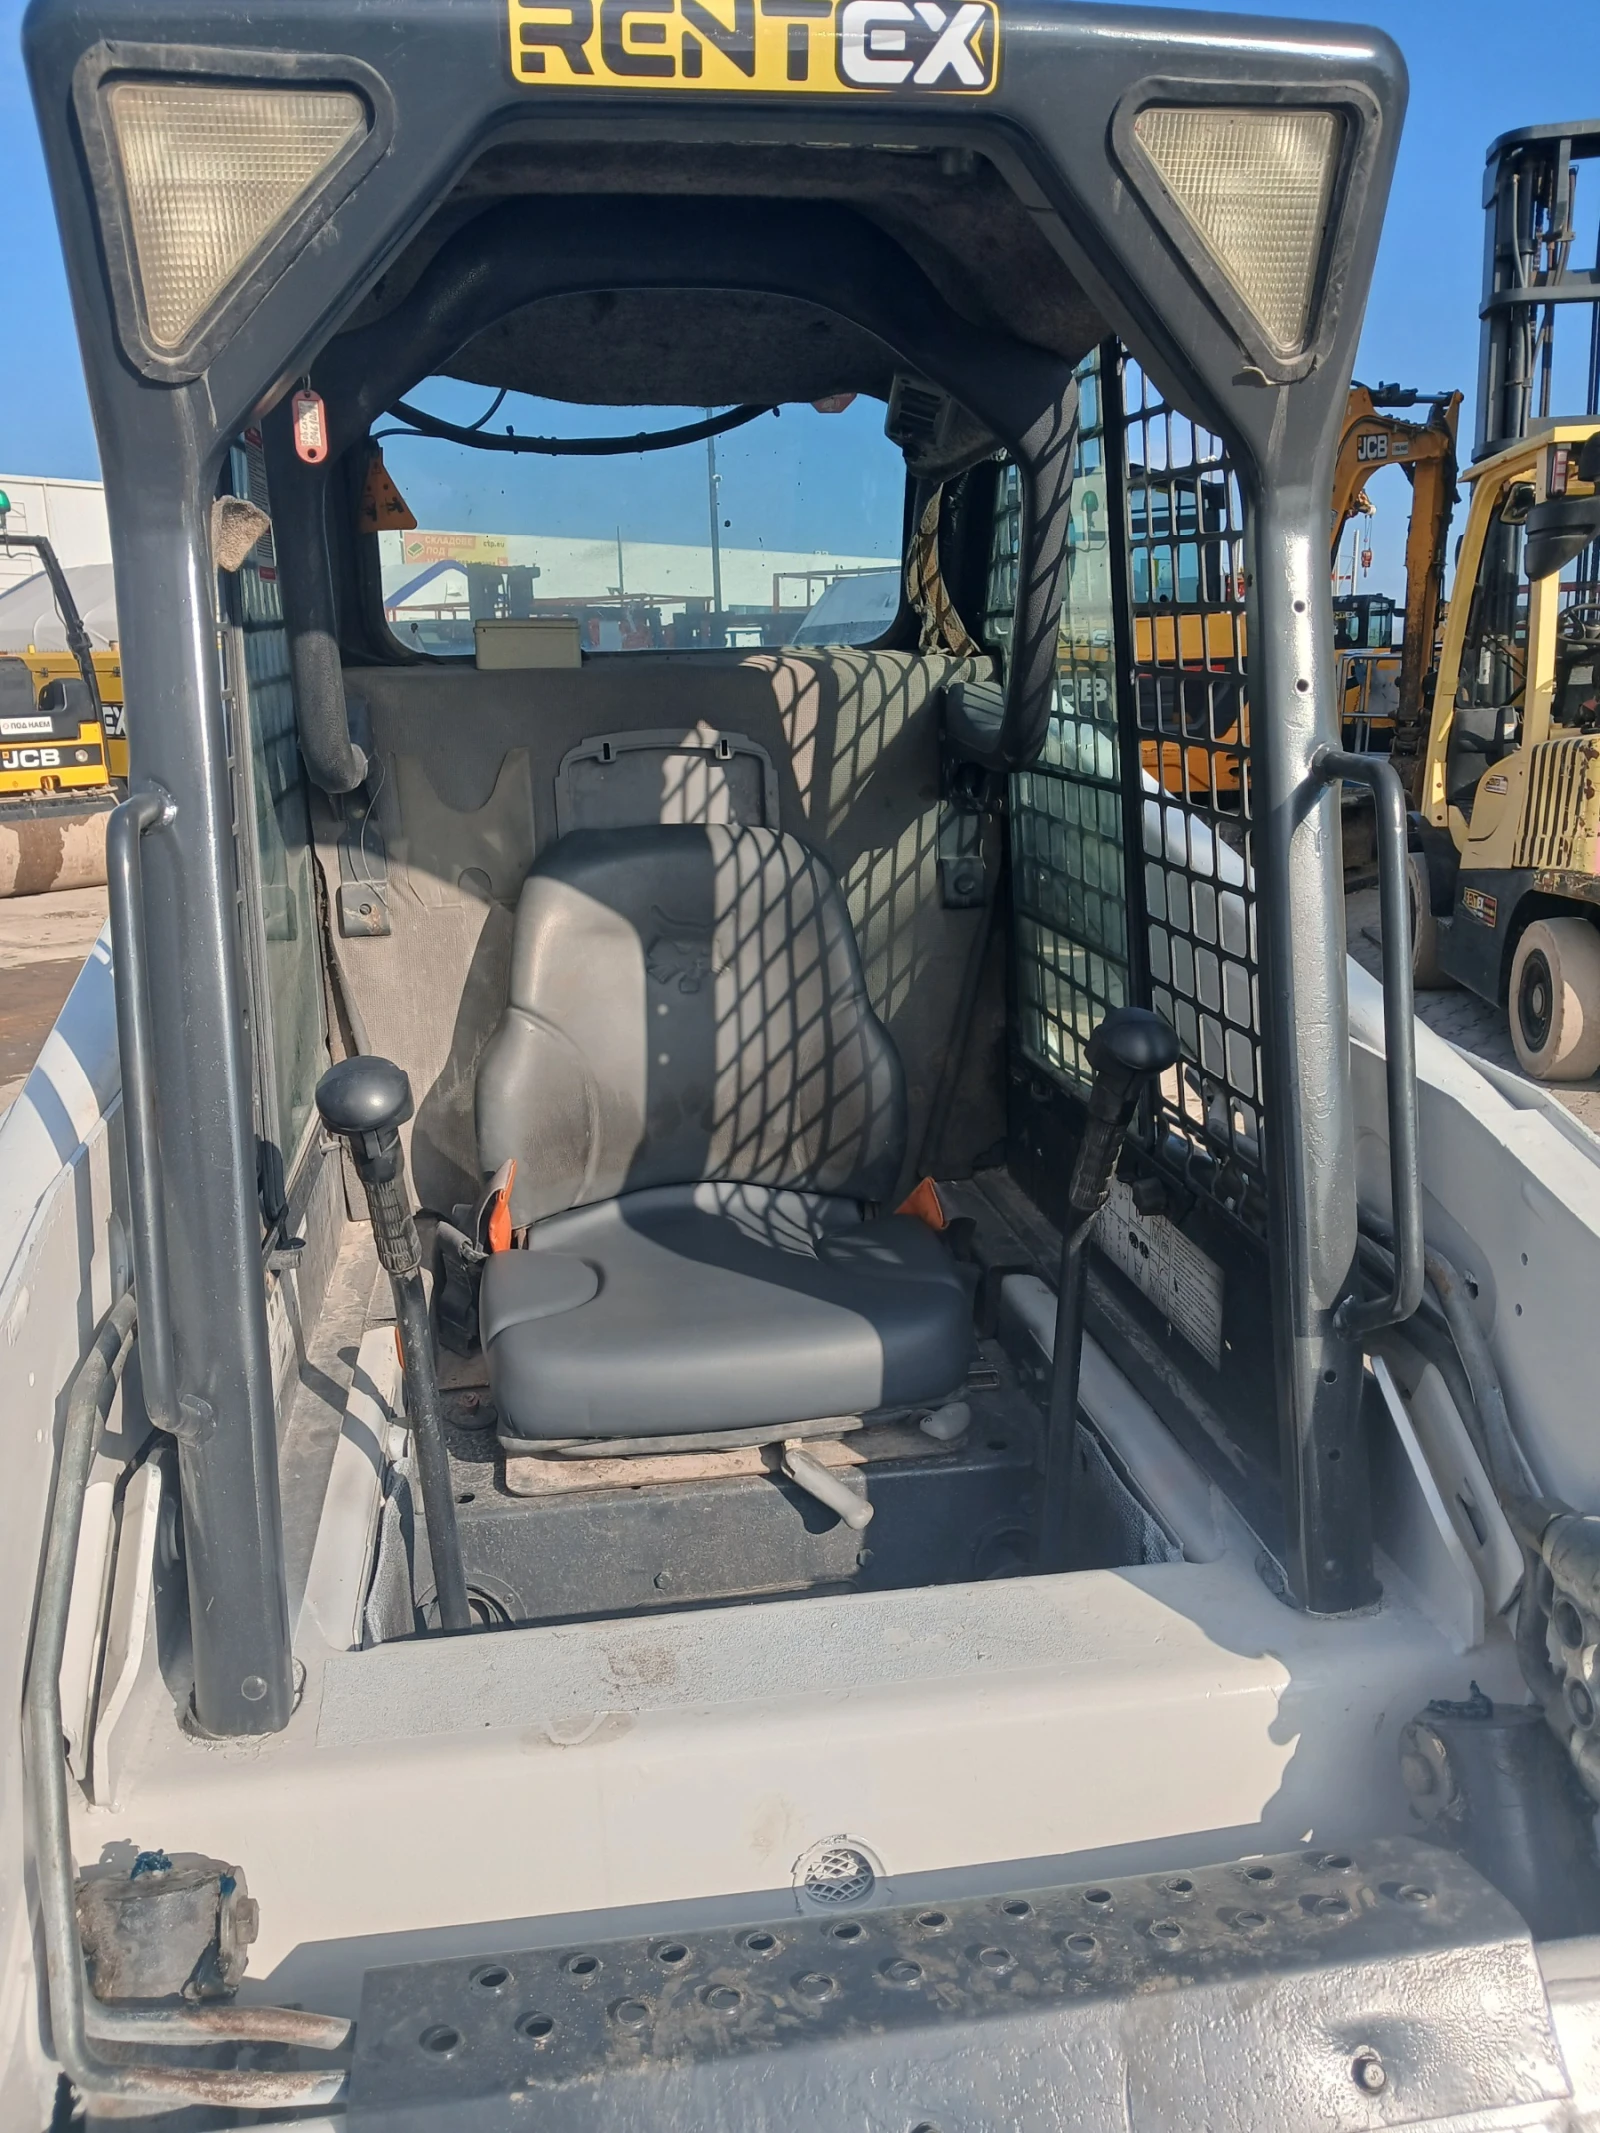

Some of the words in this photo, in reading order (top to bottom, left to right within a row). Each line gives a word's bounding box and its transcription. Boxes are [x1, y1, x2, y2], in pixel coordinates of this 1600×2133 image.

[518, 0, 986, 84] RENTEX
[1358, 434, 1388, 460] JCB
[426, 546, 446, 556] ПОД
[483, 539, 505, 549] ctp.eu
[1060, 678, 1107, 702] CB
[10, 721, 27, 730] ПОД
[28, 720, 50, 728] НАЕМ
[2, 748, 60, 768] JCB
